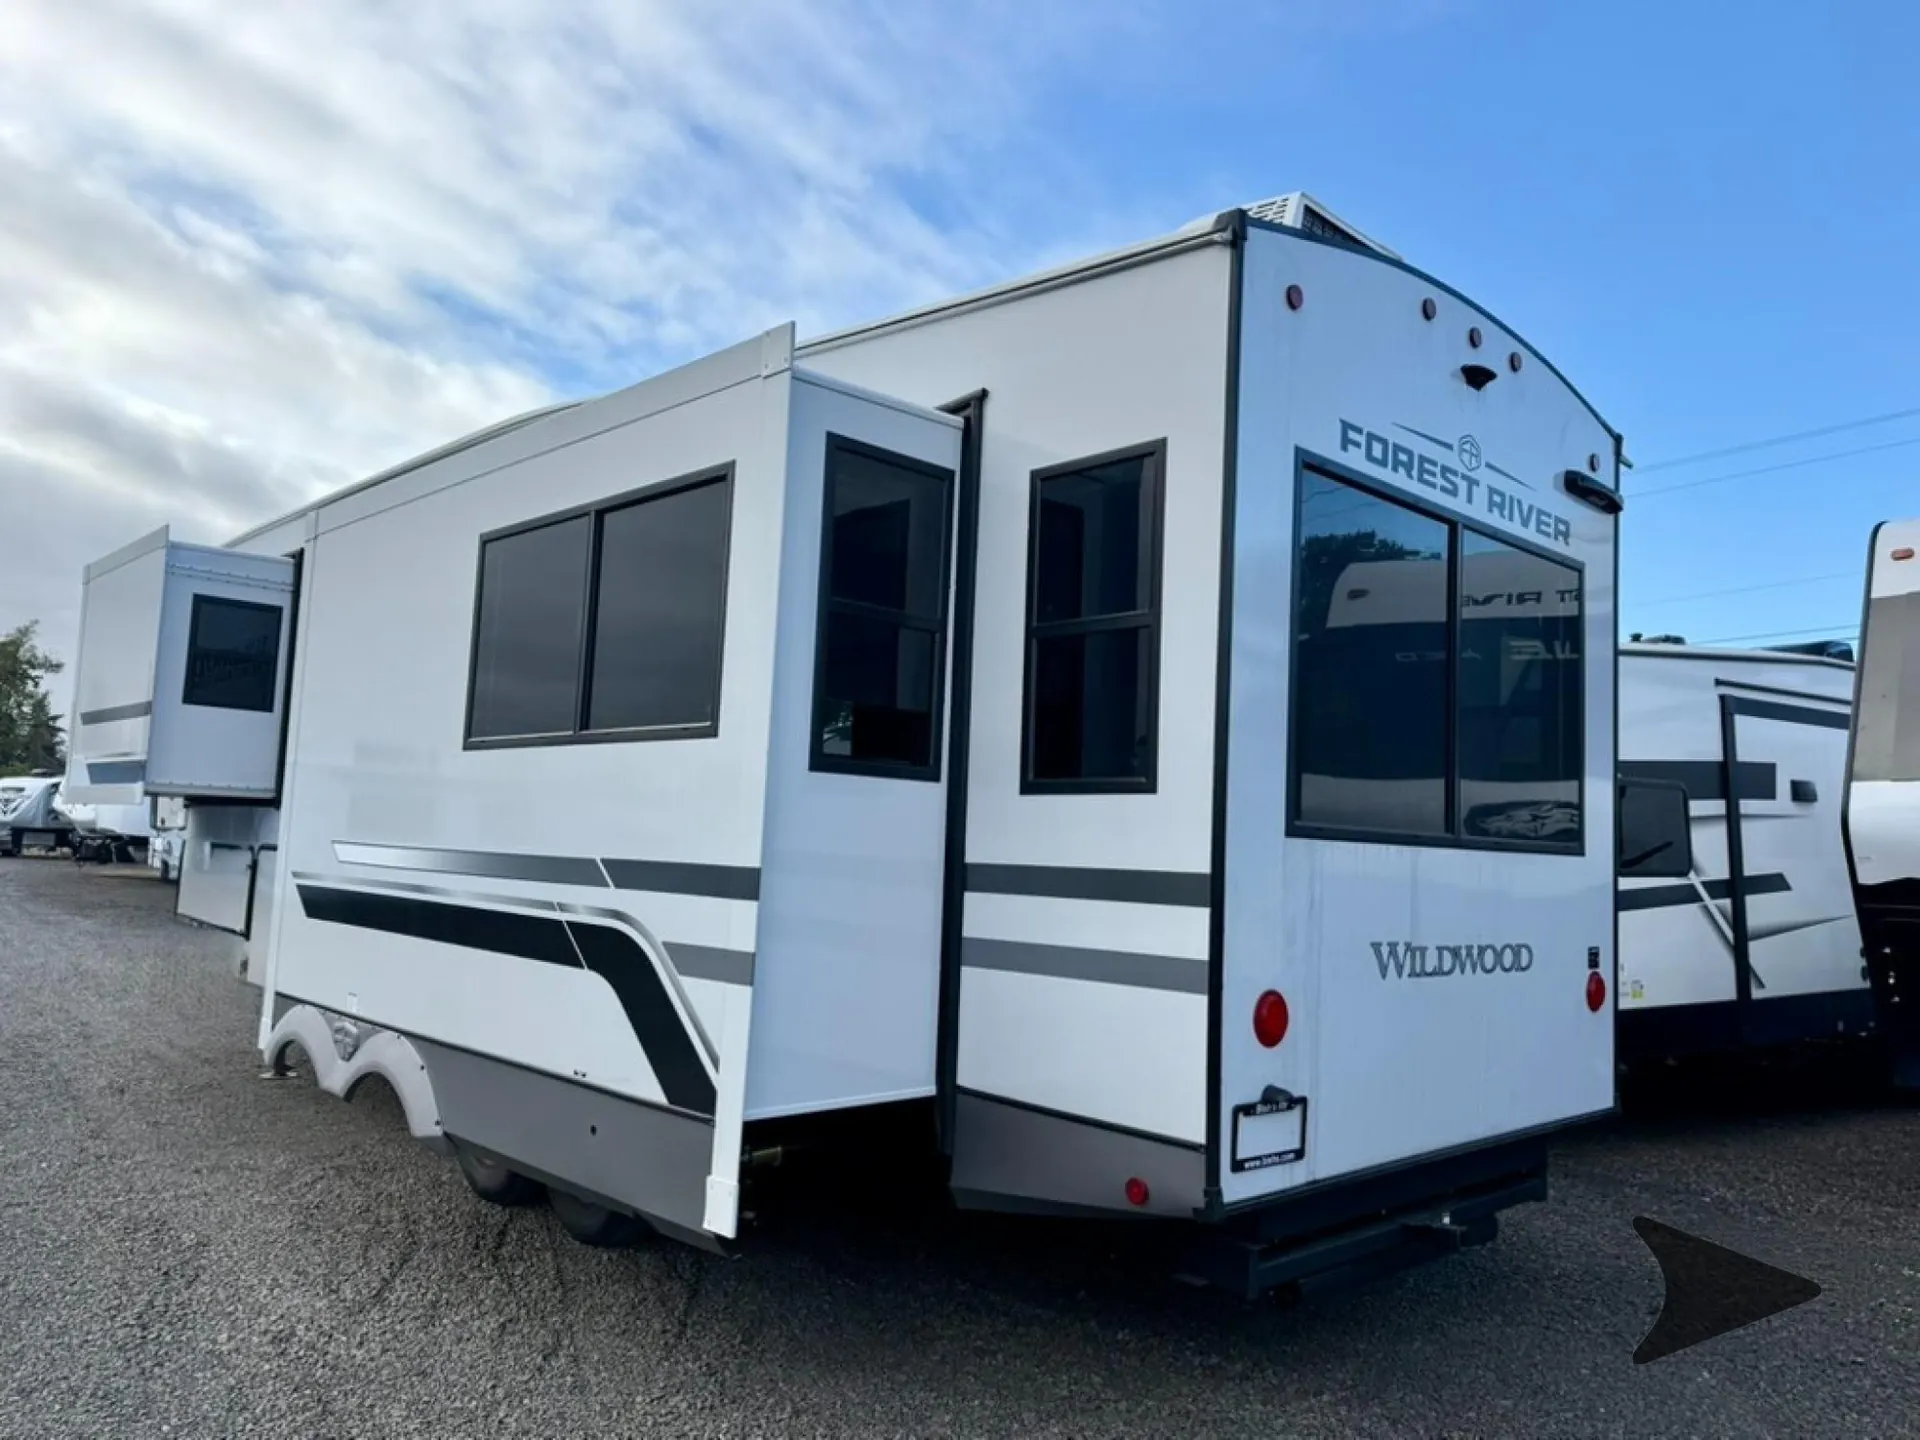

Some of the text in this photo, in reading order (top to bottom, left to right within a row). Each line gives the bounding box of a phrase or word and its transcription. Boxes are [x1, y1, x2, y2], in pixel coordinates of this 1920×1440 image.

[1339, 418, 1571, 547] FOREST RIVER
[1370, 941, 1533, 981] WILDWOOD
